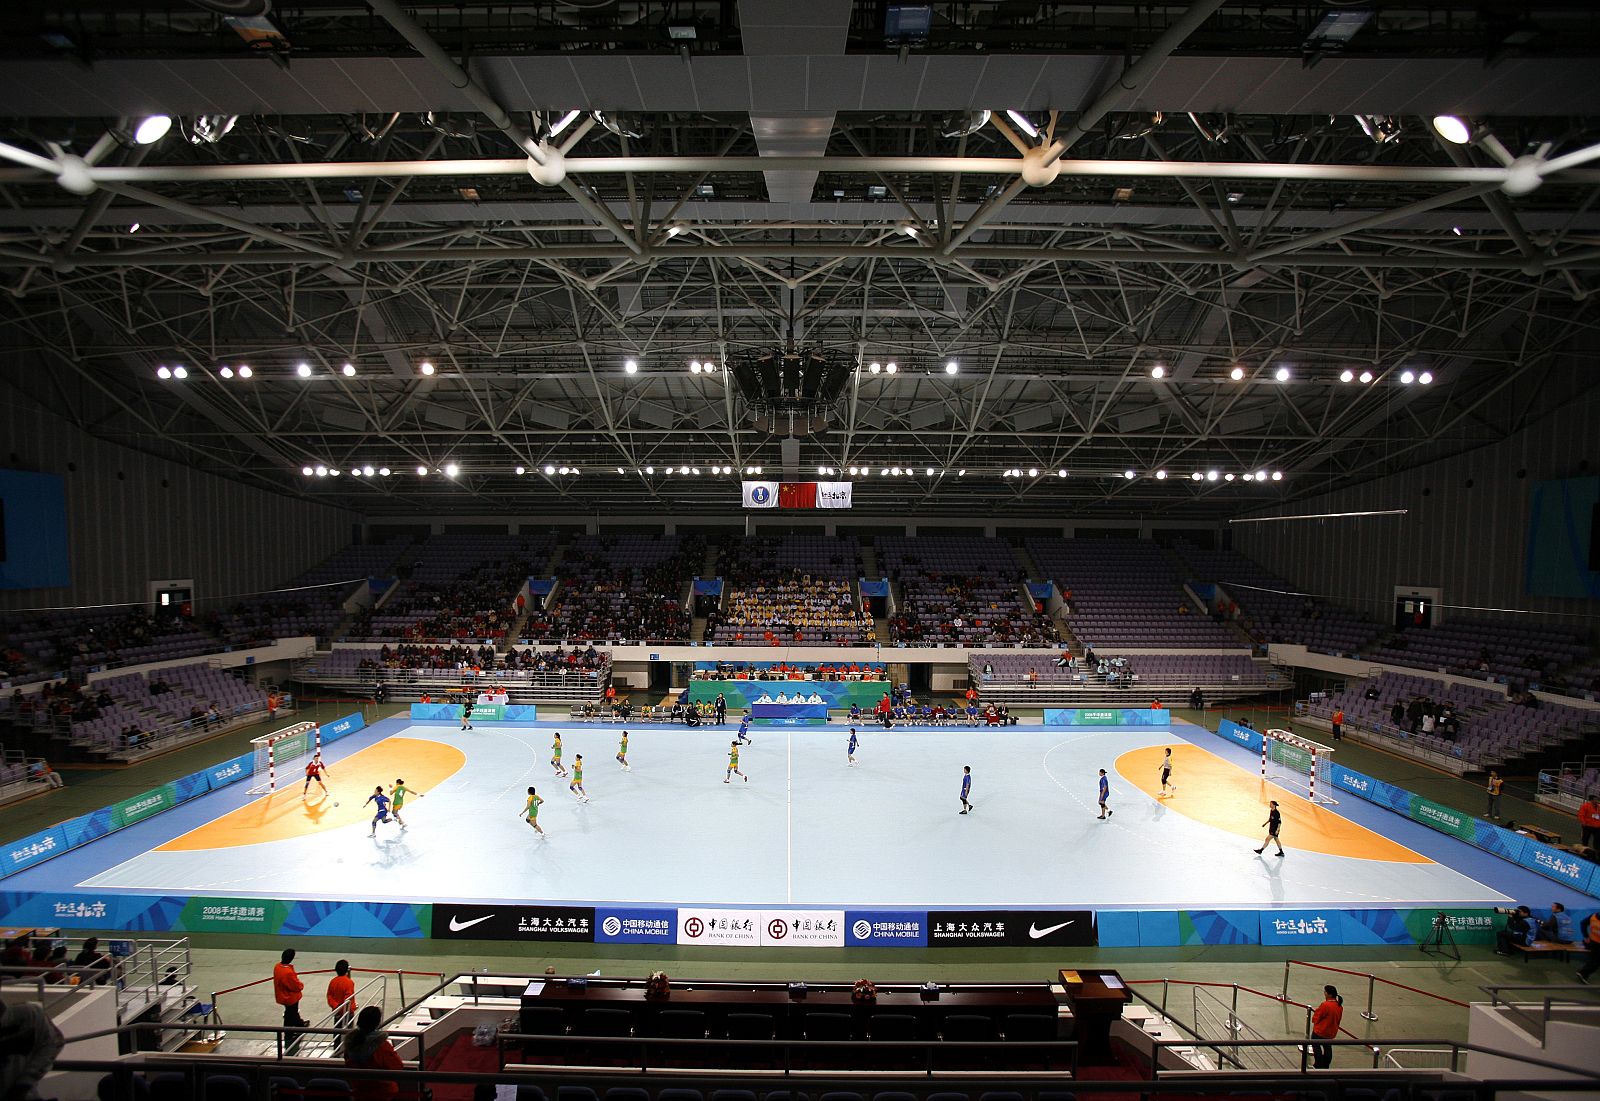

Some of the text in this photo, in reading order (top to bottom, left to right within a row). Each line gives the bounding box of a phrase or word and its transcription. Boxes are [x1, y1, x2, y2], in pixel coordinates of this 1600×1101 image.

[202, 906, 265, 916] 2008手球邀请赛
[518, 917, 589, 927] 上海大众汽车
[622, 919, 669, 929] 中国移动通信
[708, 918, 754, 931] 中国银行
[792, 919, 838, 932] 中国银行
[872, 922, 919, 931] 中国移动通信
[933, 922, 1005, 931] 上海大众汽车
[644, 928, 669, 936] MOBILE
